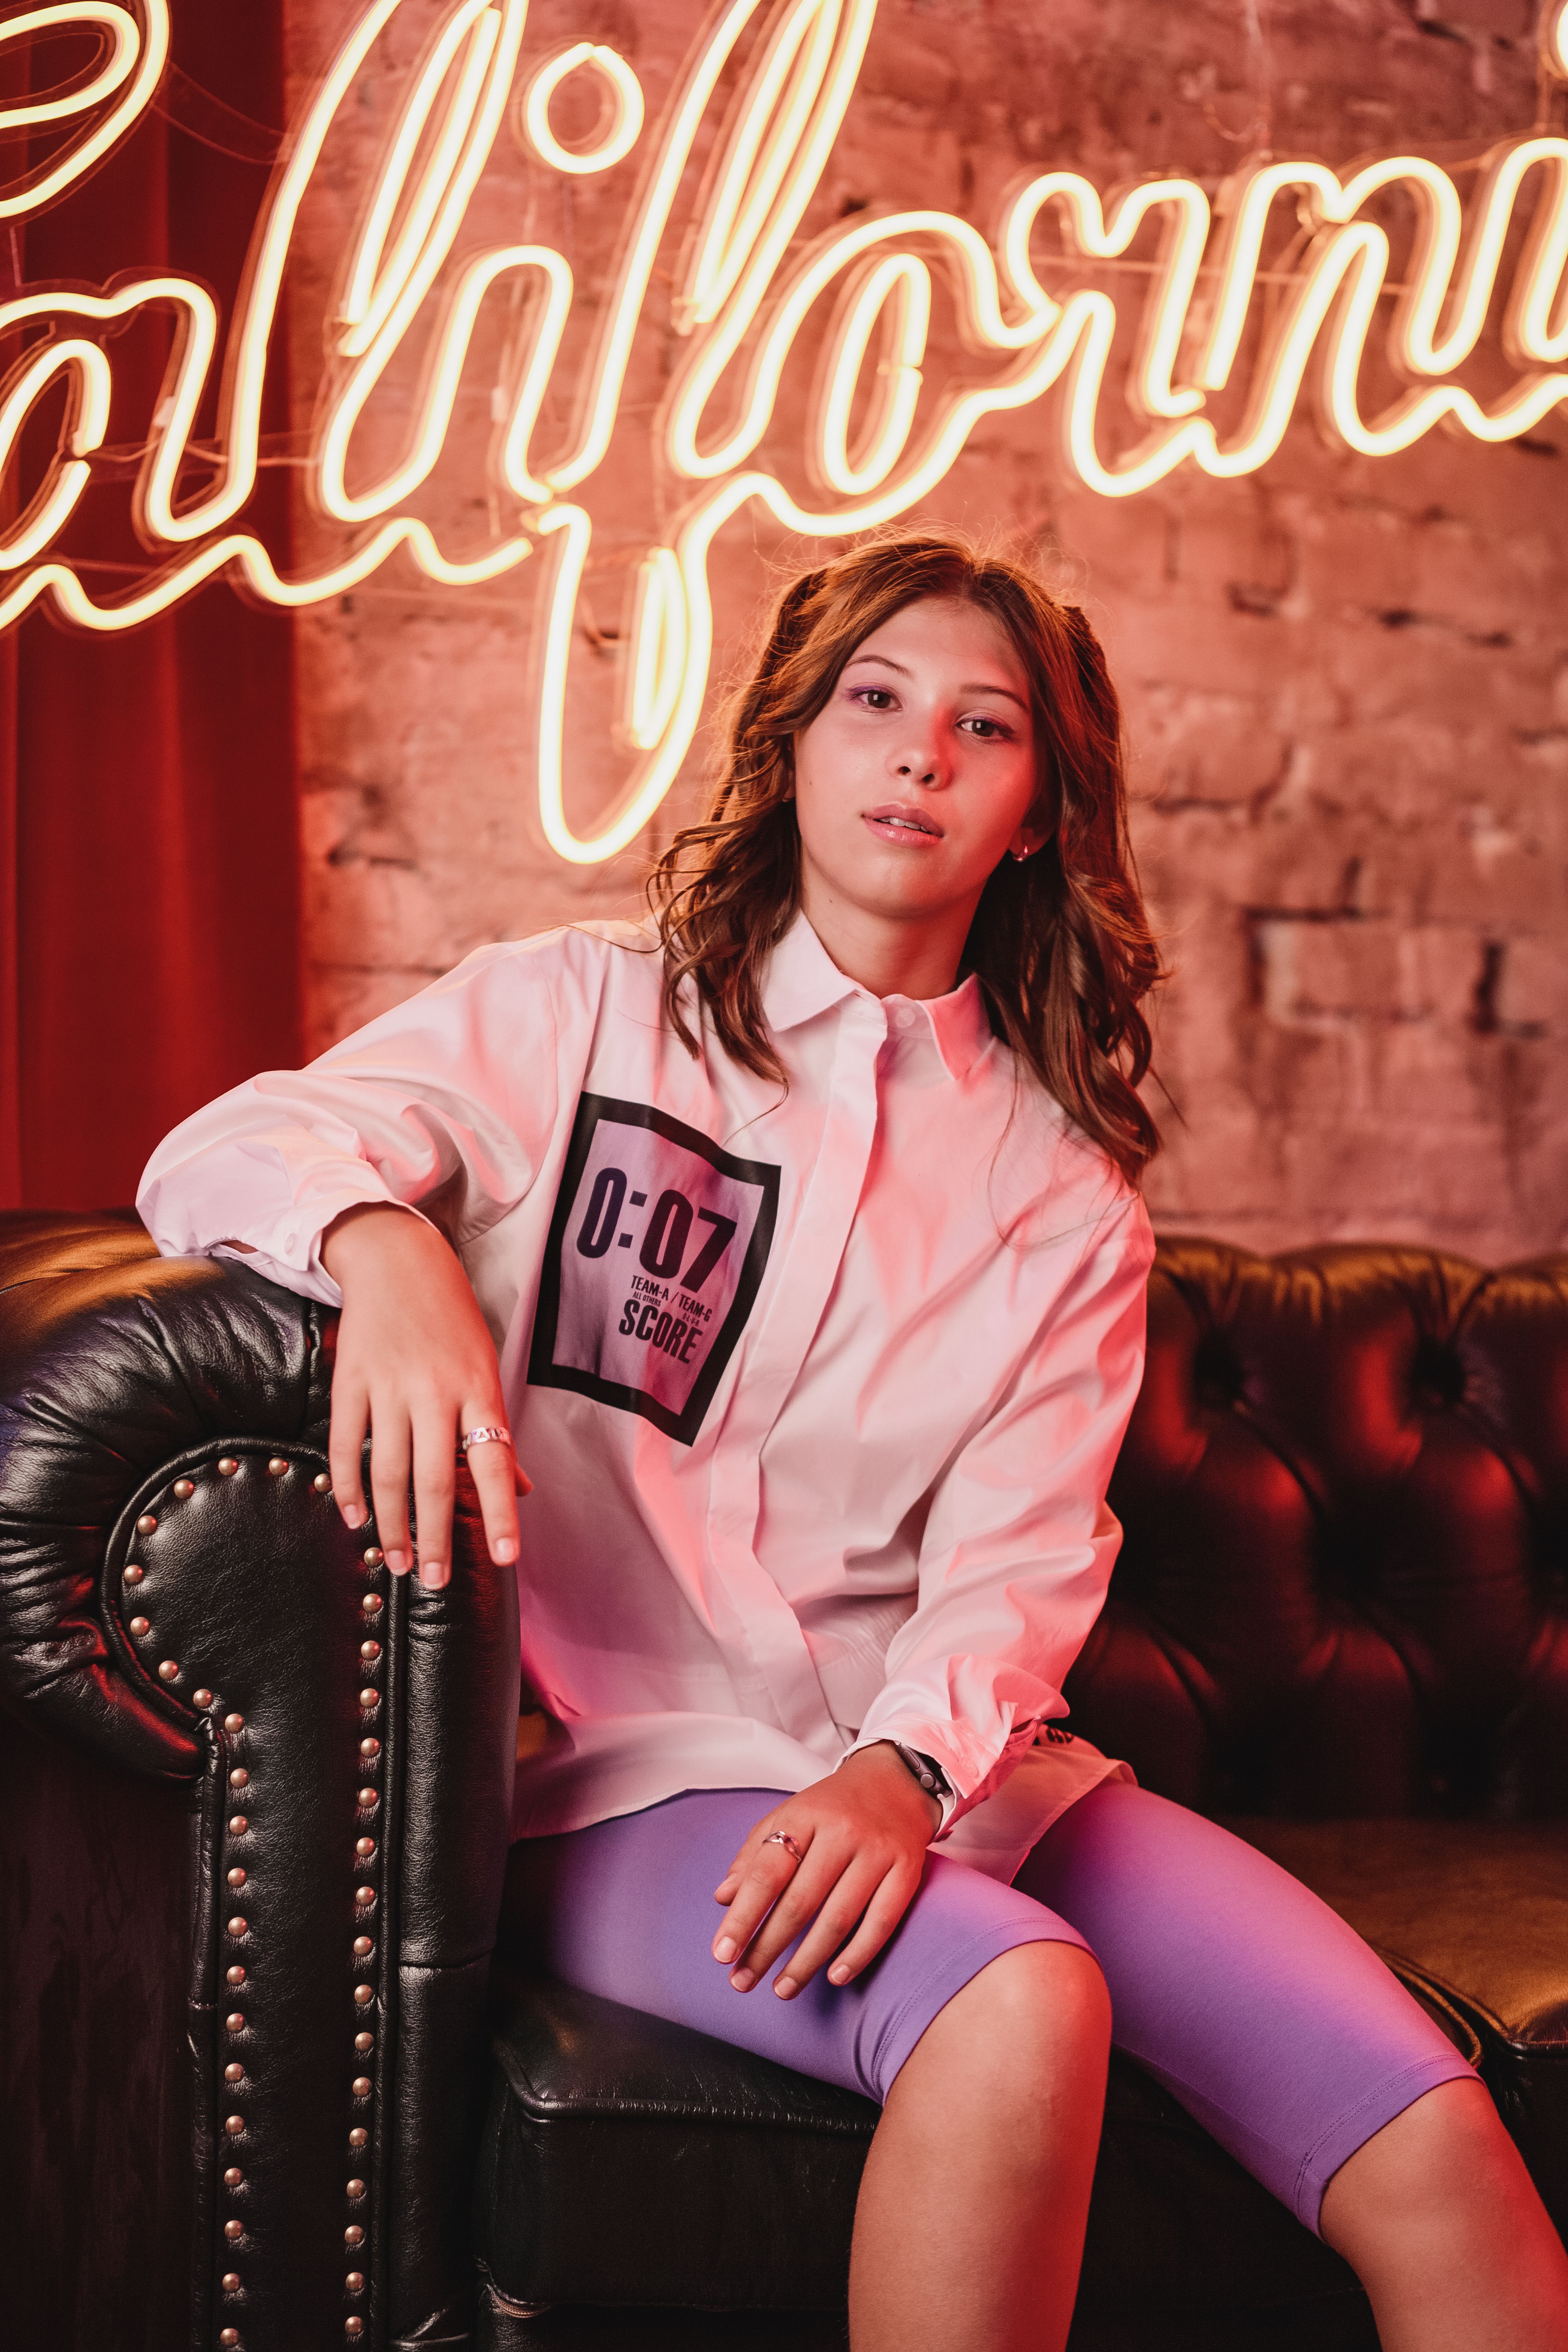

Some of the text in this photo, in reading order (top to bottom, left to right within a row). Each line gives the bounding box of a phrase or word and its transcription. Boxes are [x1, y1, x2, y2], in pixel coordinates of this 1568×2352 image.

[576, 1167, 737, 1293] 0:07
[631, 1275, 669, 1301] TEAM-A
[678, 1294, 712, 1322] TEAM-G
[632, 1291, 662, 1307] ALL OTHERS
[619, 1299, 703, 1364] SCORE
